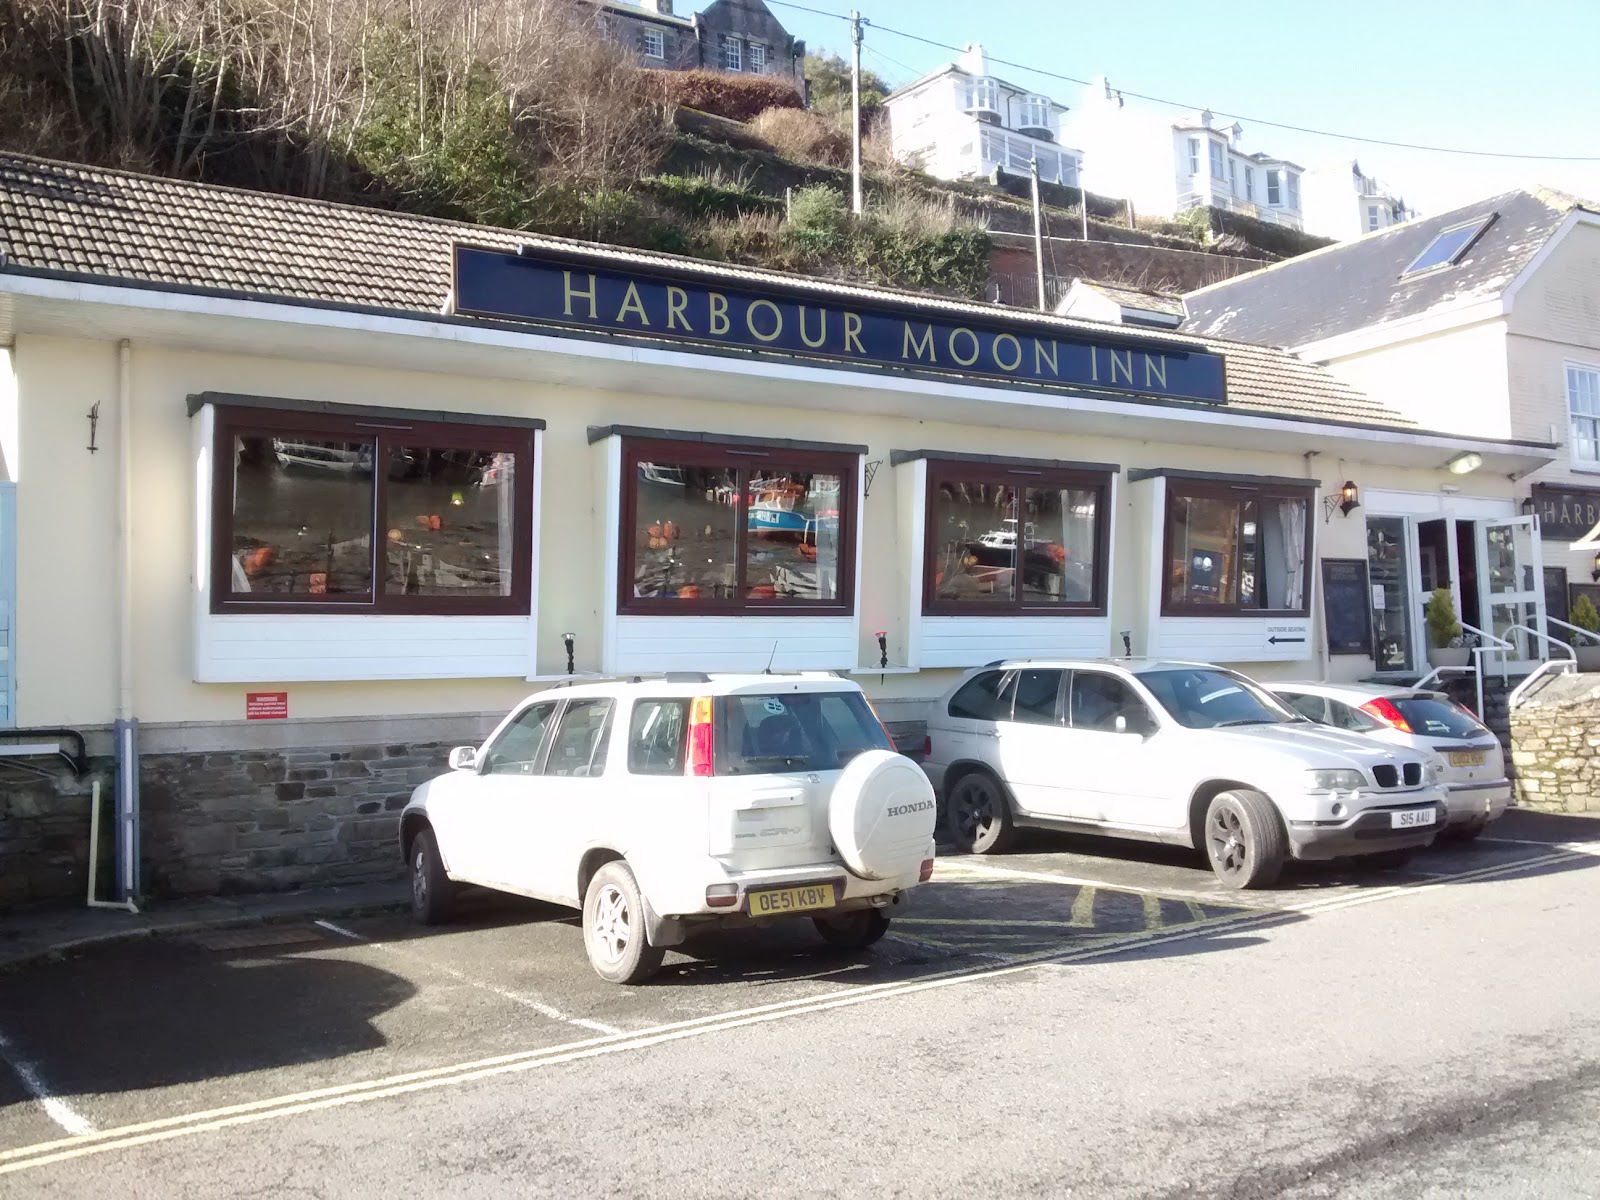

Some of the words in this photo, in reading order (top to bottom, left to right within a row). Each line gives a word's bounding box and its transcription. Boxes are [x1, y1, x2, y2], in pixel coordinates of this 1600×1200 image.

[563, 270, 867, 353] HARBOUR
[902, 321, 1059, 377] MOON
[1091, 345, 1168, 389] INN
[1544, 501, 1599, 525] HARB
[887, 800, 935, 817] HONDA
[1400, 813, 1414, 825] S15
[1416, 811, 1430, 824] AAU
[798, 888, 826, 907] KBV
